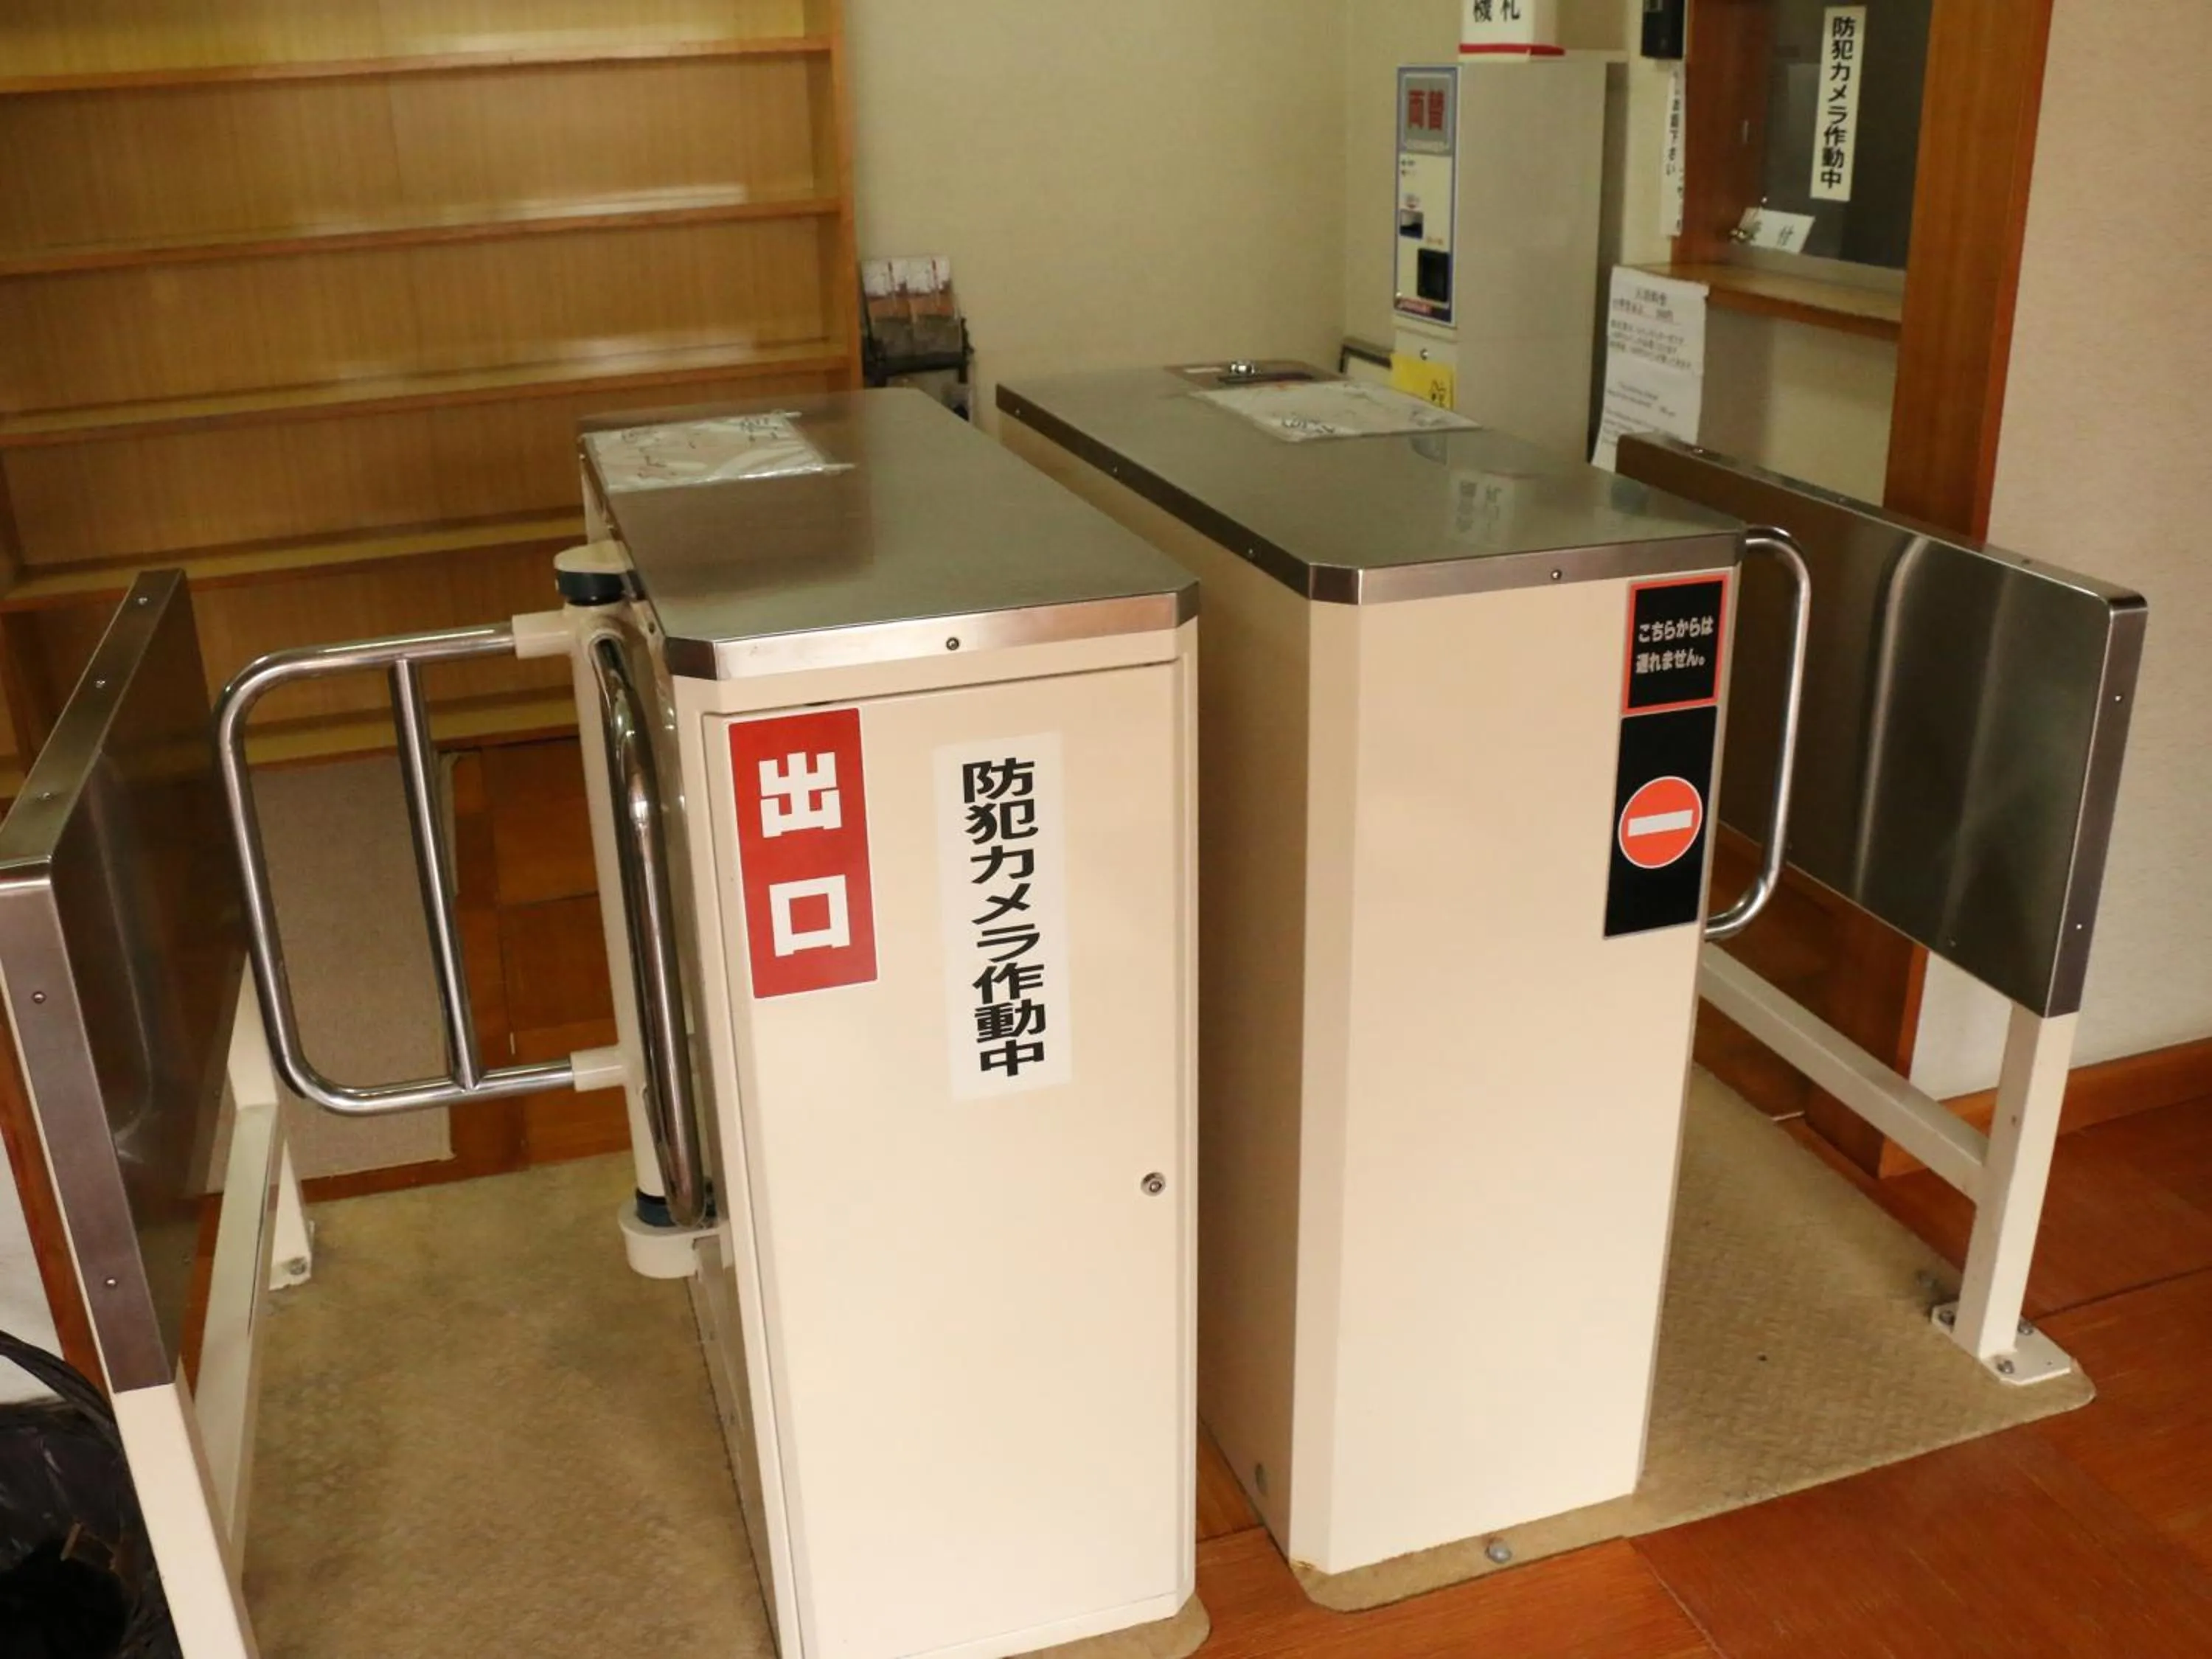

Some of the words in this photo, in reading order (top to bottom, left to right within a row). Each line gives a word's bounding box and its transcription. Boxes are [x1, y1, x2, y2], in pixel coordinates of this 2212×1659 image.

[1820, 16, 1856, 189] 防犯カメラ作動中
[1635, 648, 1706, 674] 通れません。
[1638, 615, 1714, 643] こちらからは
[758, 751, 850, 957] 出口
[962, 757, 1047, 1077] 防犯カメラ作動中
